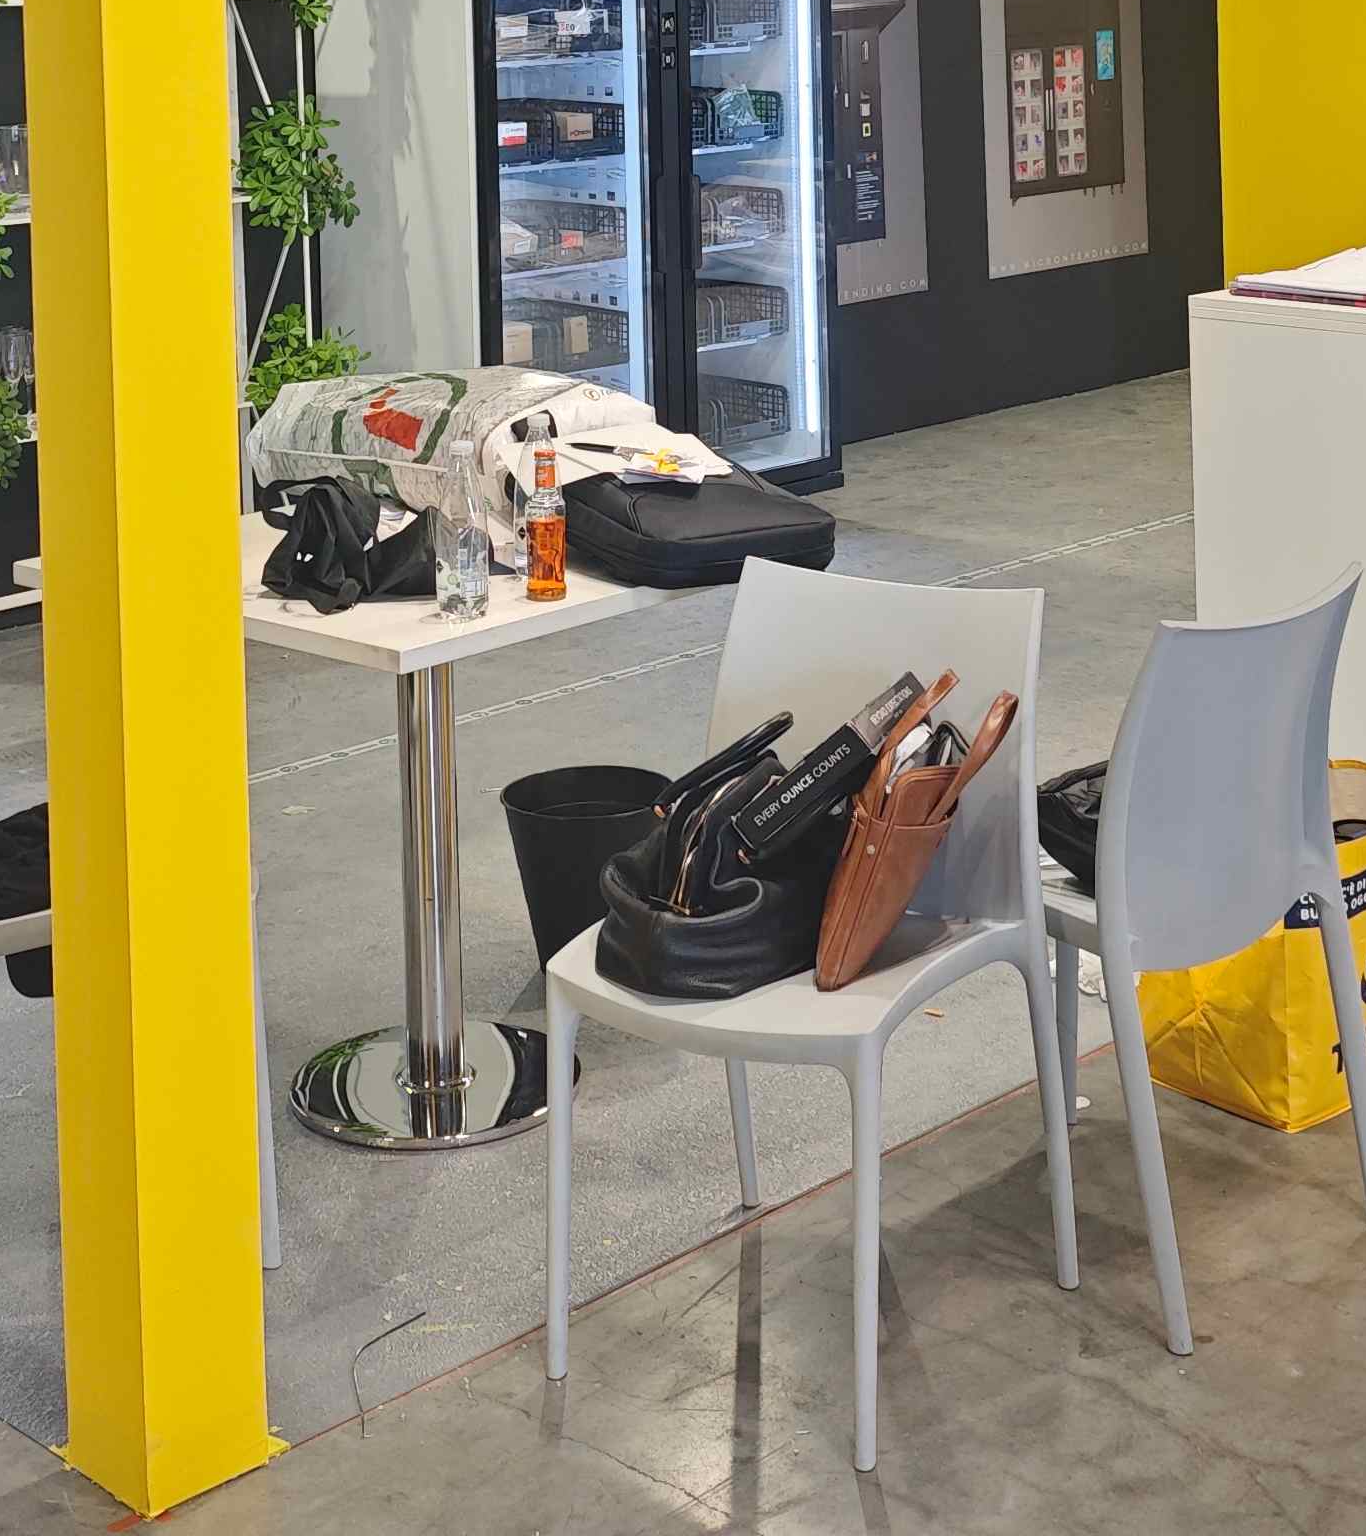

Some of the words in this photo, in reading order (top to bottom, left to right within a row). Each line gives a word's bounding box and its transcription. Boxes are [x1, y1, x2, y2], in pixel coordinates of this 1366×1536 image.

[753, 798, 782, 827] EVERY
[780, 772, 815, 805] OUNCE
[812, 743, 852, 778] COUNTS
[1356, 877, 1366, 893] DI
